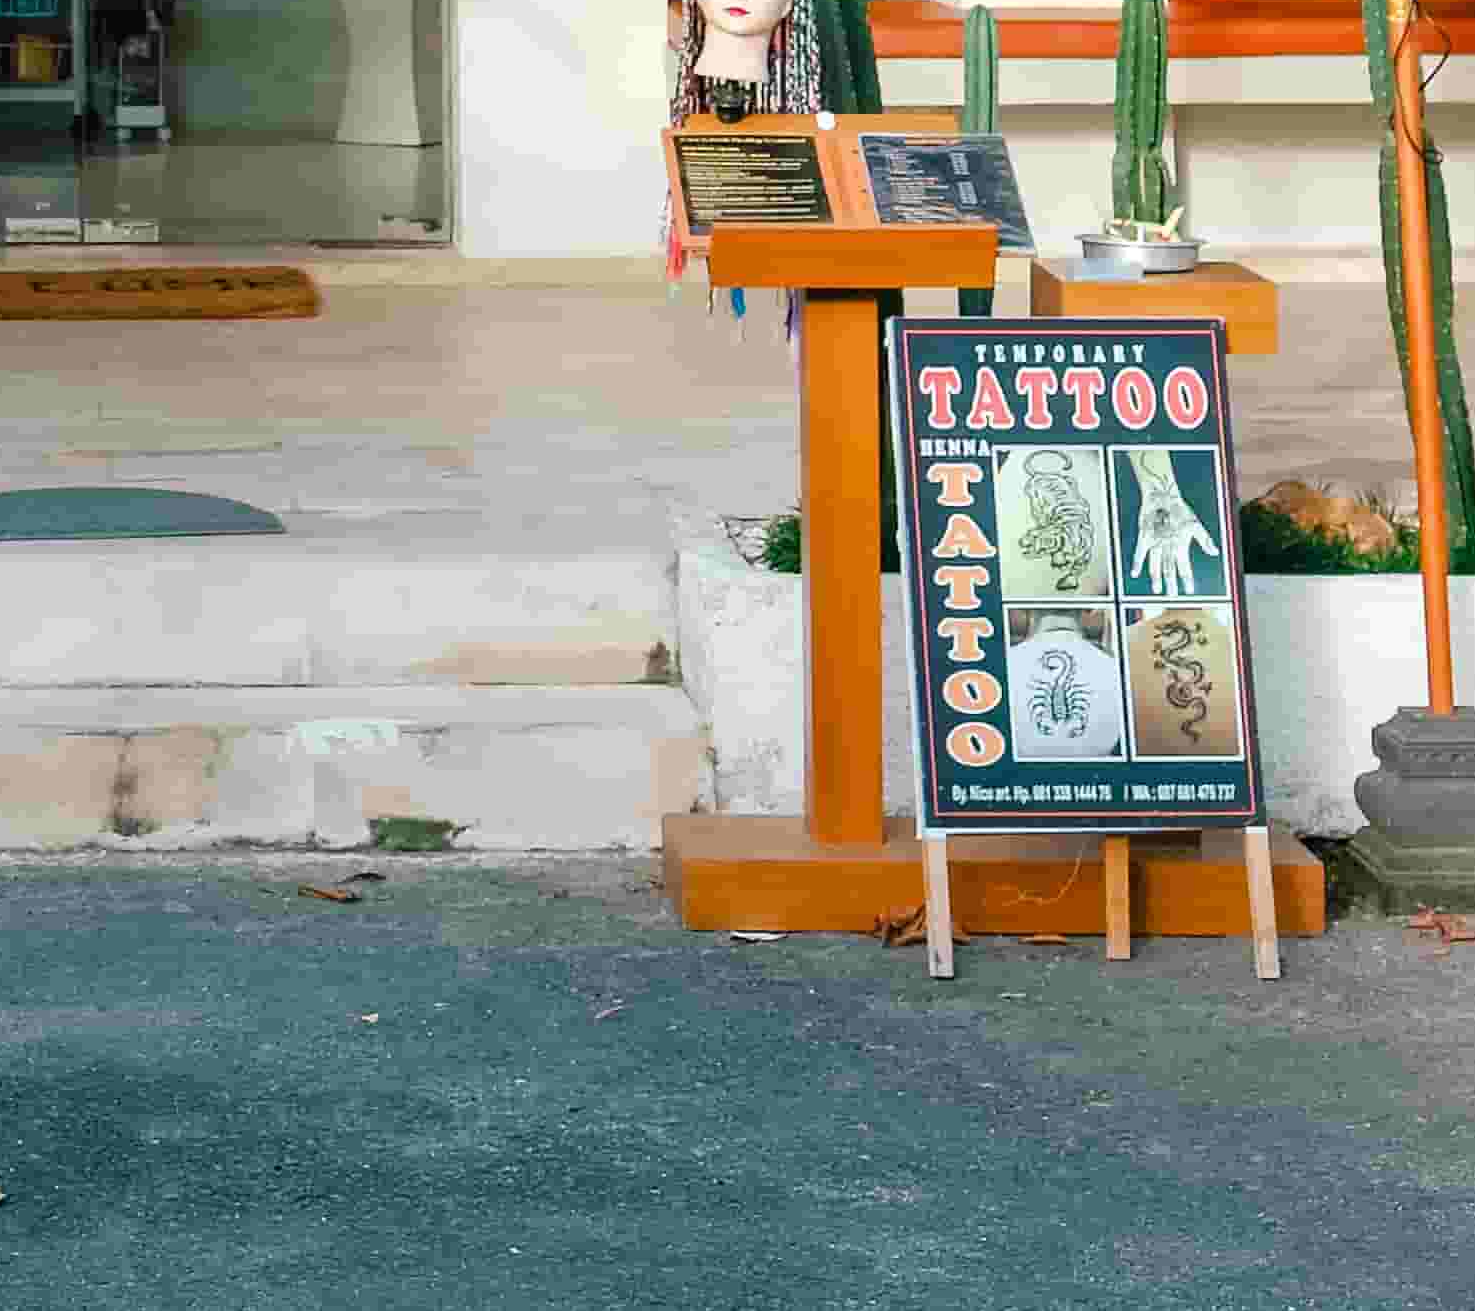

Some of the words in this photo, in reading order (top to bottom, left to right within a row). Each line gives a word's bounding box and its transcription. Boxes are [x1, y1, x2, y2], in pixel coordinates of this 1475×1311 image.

[974, 344, 1146, 364] TEMPORARY
[918, 365, 1209, 430] TATTOO
[919, 438, 992, 457] HENNA
[926, 461, 1006, 768] TATTOO
